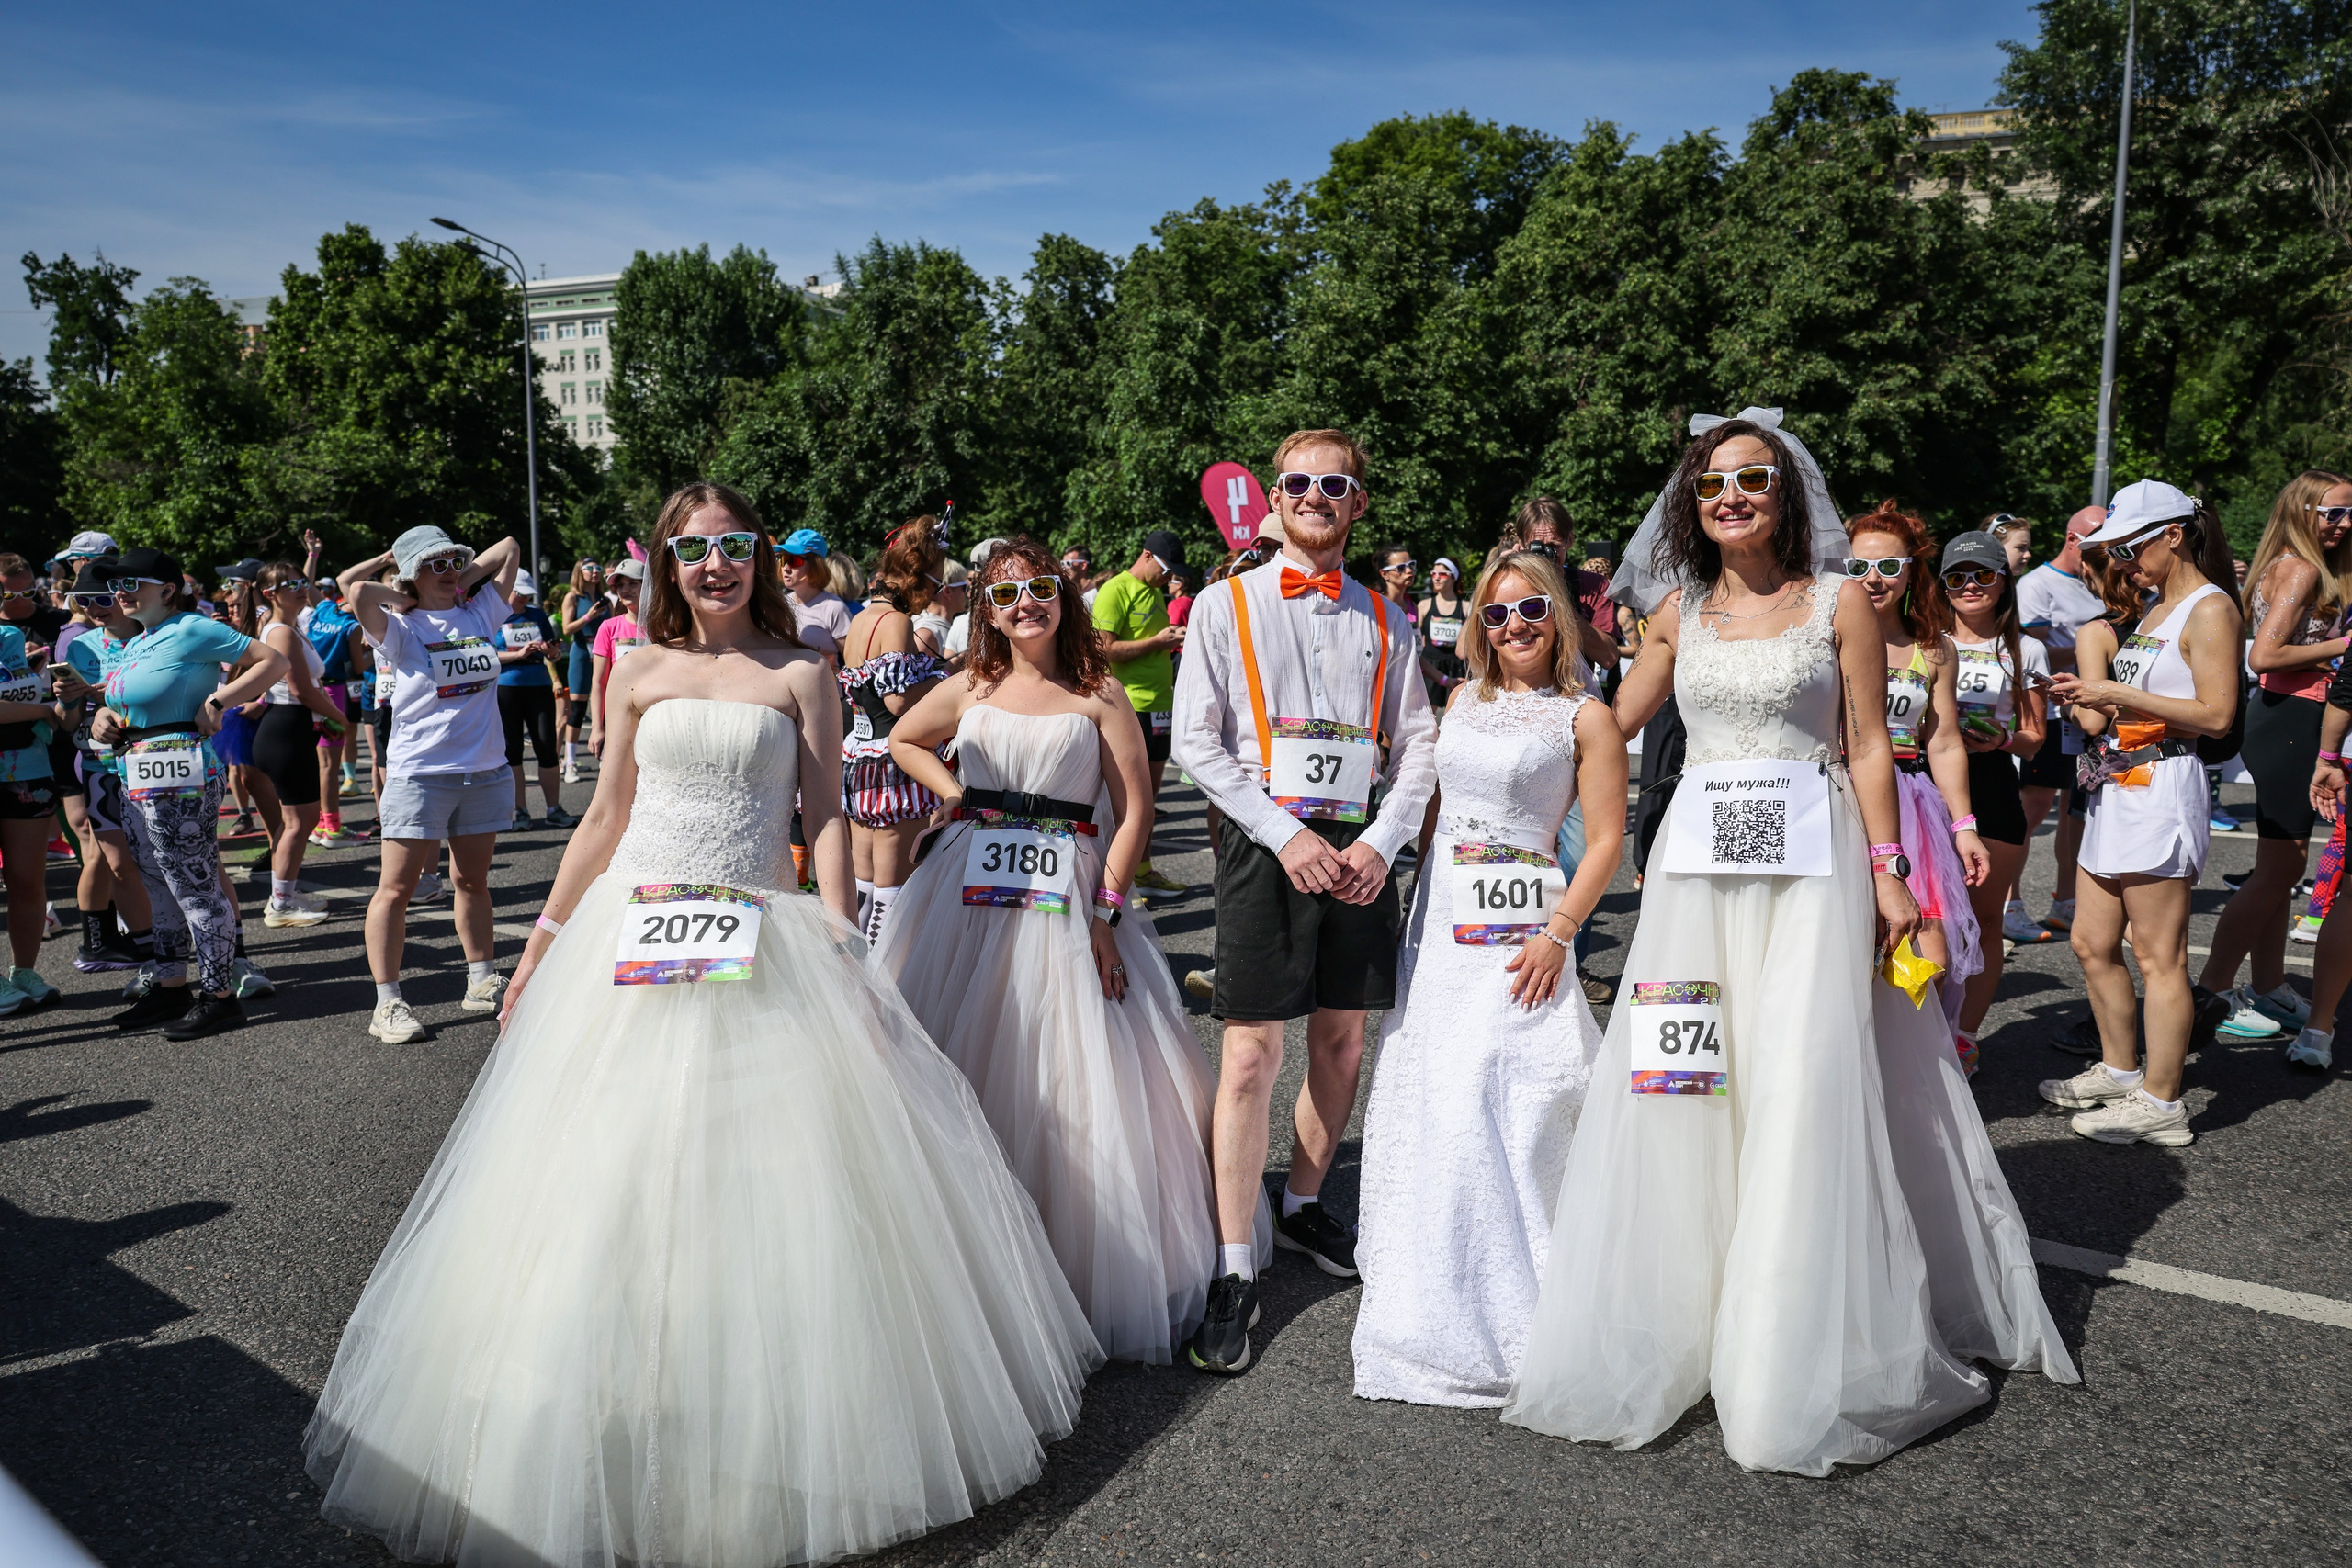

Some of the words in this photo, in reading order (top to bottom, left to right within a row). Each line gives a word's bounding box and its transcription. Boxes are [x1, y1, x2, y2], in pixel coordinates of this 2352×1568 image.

[514, 632, 533, 643] 631
[1433, 626, 1457, 638] 3703
[88, 657, 120, 667] ENERG
[441, 654, 492, 678] 7040
[1, 684, 36, 702] 5055
[1332, 734, 1374, 746] 2026
[138, 760, 191, 780] 5015
[1306, 753, 1343, 784] 37
[1704, 780, 1733, 792] Ищу
[1736, 777, 1791, 791] мужа!!!
[1032, 824, 1073, 841] 2026
[981, 842, 1058, 877] 3180
[1472, 878, 1543, 910] 1601
[639, 913, 740, 945] 2079
[1658, 1020, 1721, 1055] 874
